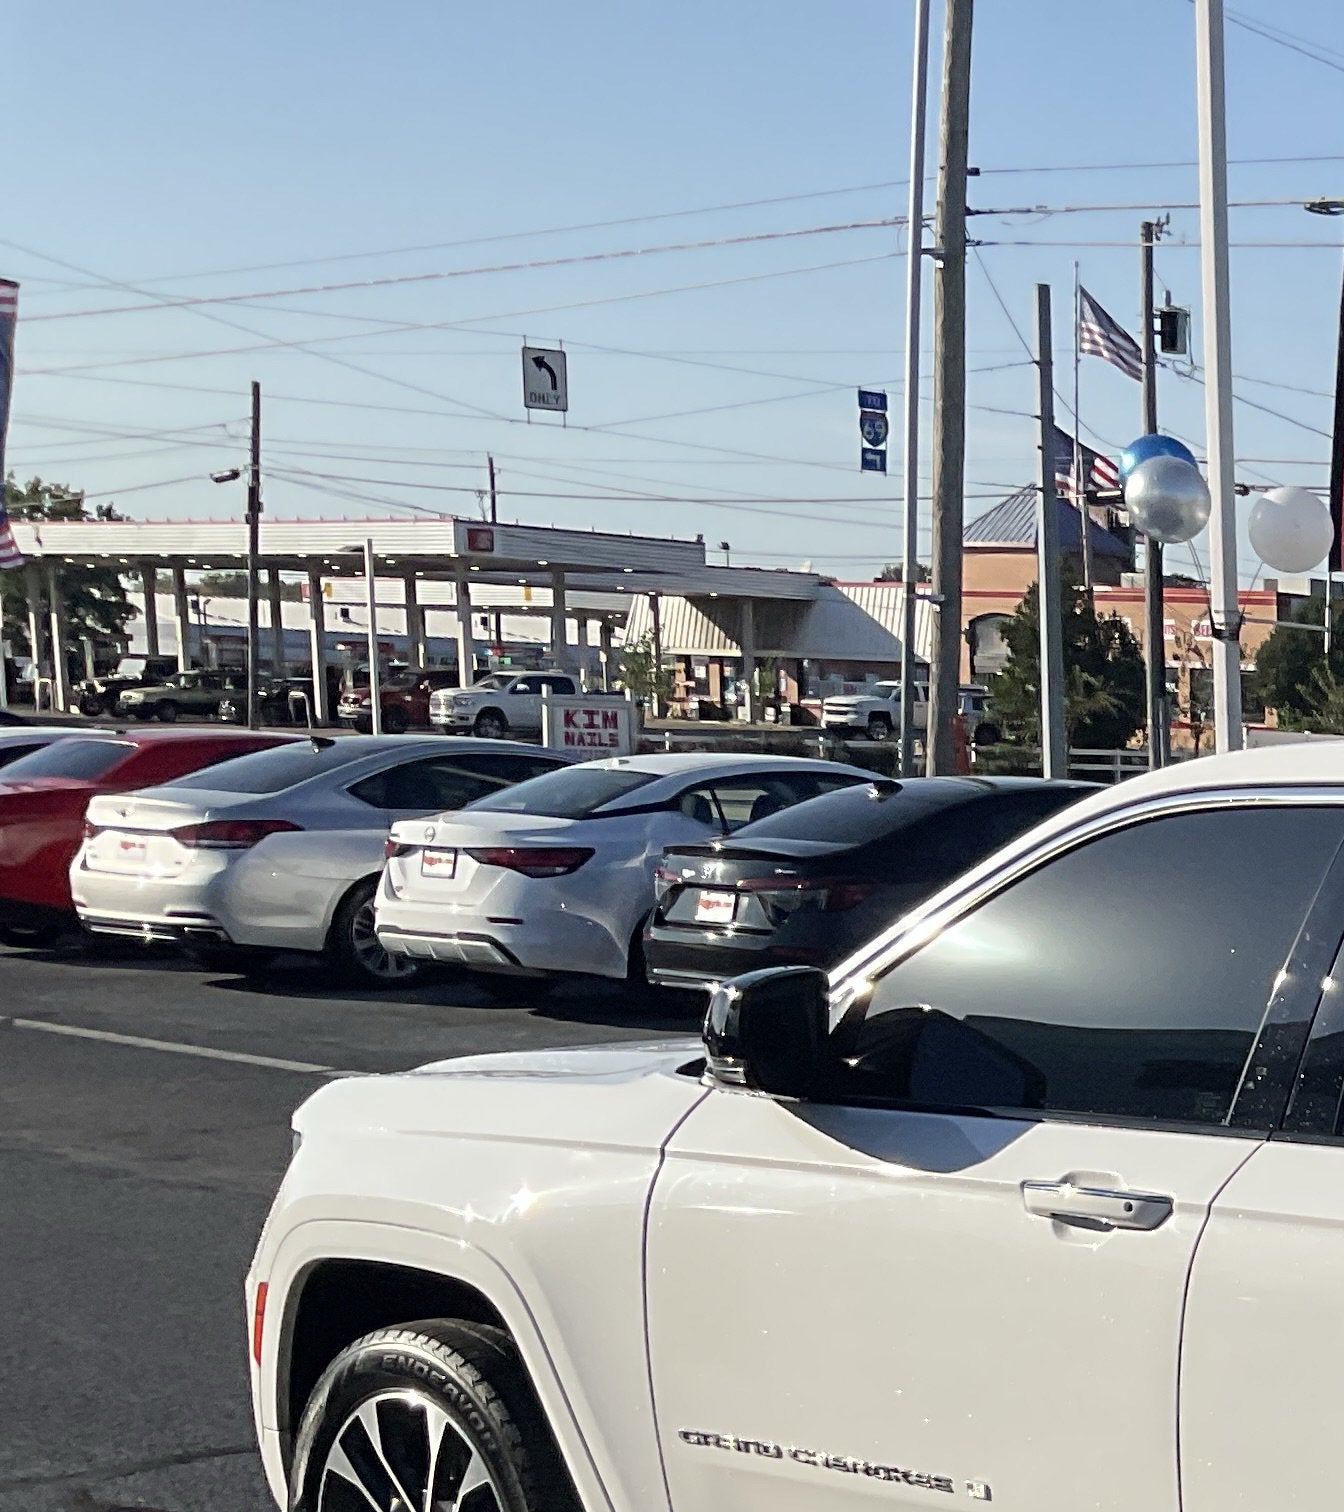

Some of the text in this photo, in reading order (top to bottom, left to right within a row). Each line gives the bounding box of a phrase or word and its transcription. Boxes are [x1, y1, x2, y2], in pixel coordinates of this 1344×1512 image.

[530, 392, 560, 405] ONLY
[864, 420, 886, 440] 69
[563, 709, 619, 729] KIM
[564, 731, 620, 748] NAILS
